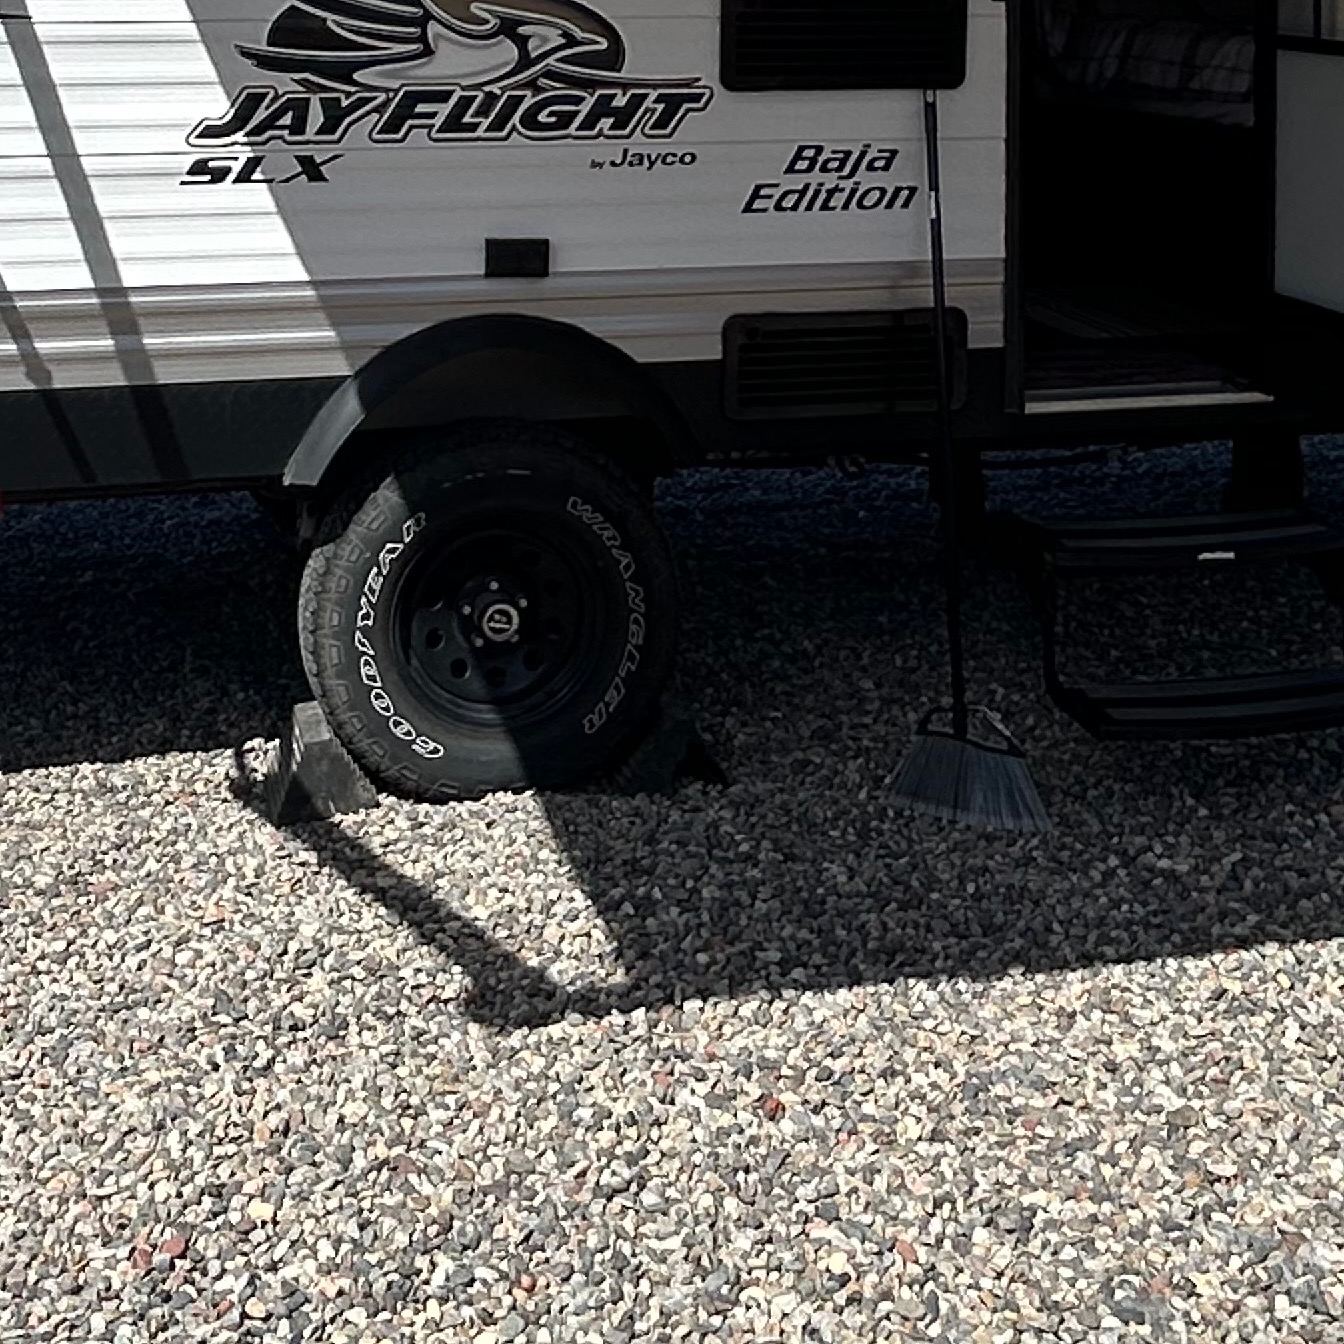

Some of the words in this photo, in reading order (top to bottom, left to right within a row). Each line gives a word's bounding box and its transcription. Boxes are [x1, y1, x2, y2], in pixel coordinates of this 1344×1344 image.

[185, 85, 389, 147] JAY
[368, 83, 714, 144] FLIGHT
[179, 154, 346, 186] SLX
[588, 158, 606, 170] by
[608, 147, 698, 172] Jayco
[783, 142, 899, 180] Baja
[740, 181, 920, 214] Edition
[566, 496, 646, 734] WRANGLER
